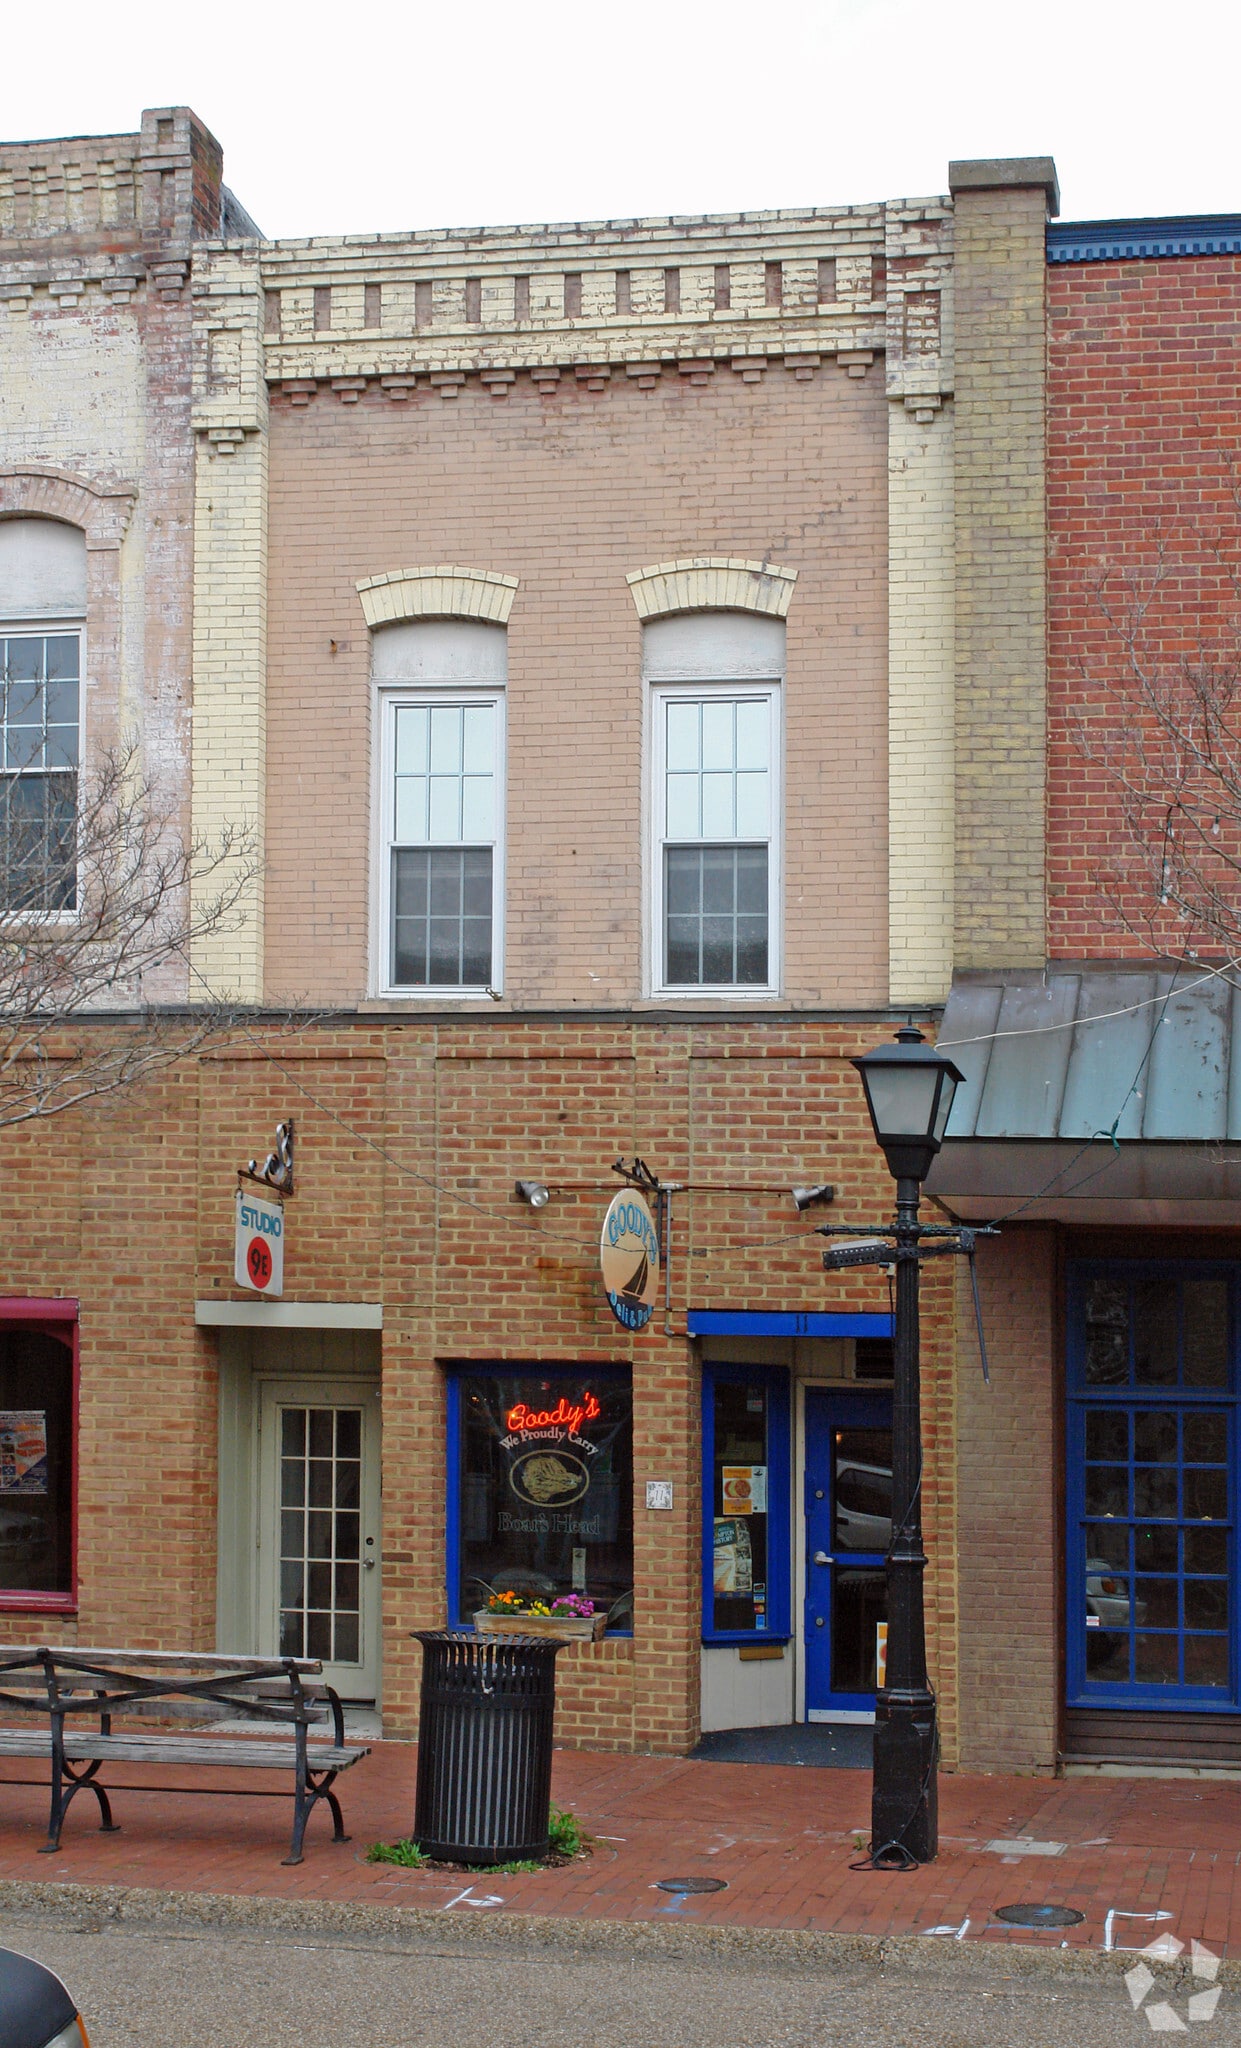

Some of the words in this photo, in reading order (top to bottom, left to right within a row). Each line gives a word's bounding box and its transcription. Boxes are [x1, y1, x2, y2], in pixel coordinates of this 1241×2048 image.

[241, 1206, 282, 1237] STUDIO
[251, 1248, 268, 1276] 9E
[508, 1392, 600, 1432] Goody's
[499, 1434, 519, 1450] We
[520, 1427, 566, 1442] Proudly
[568, 1431, 599, 1455] Carry
[498, 1512, 549, 1533] Boar's
[552, 1514, 600, 1535] Head
